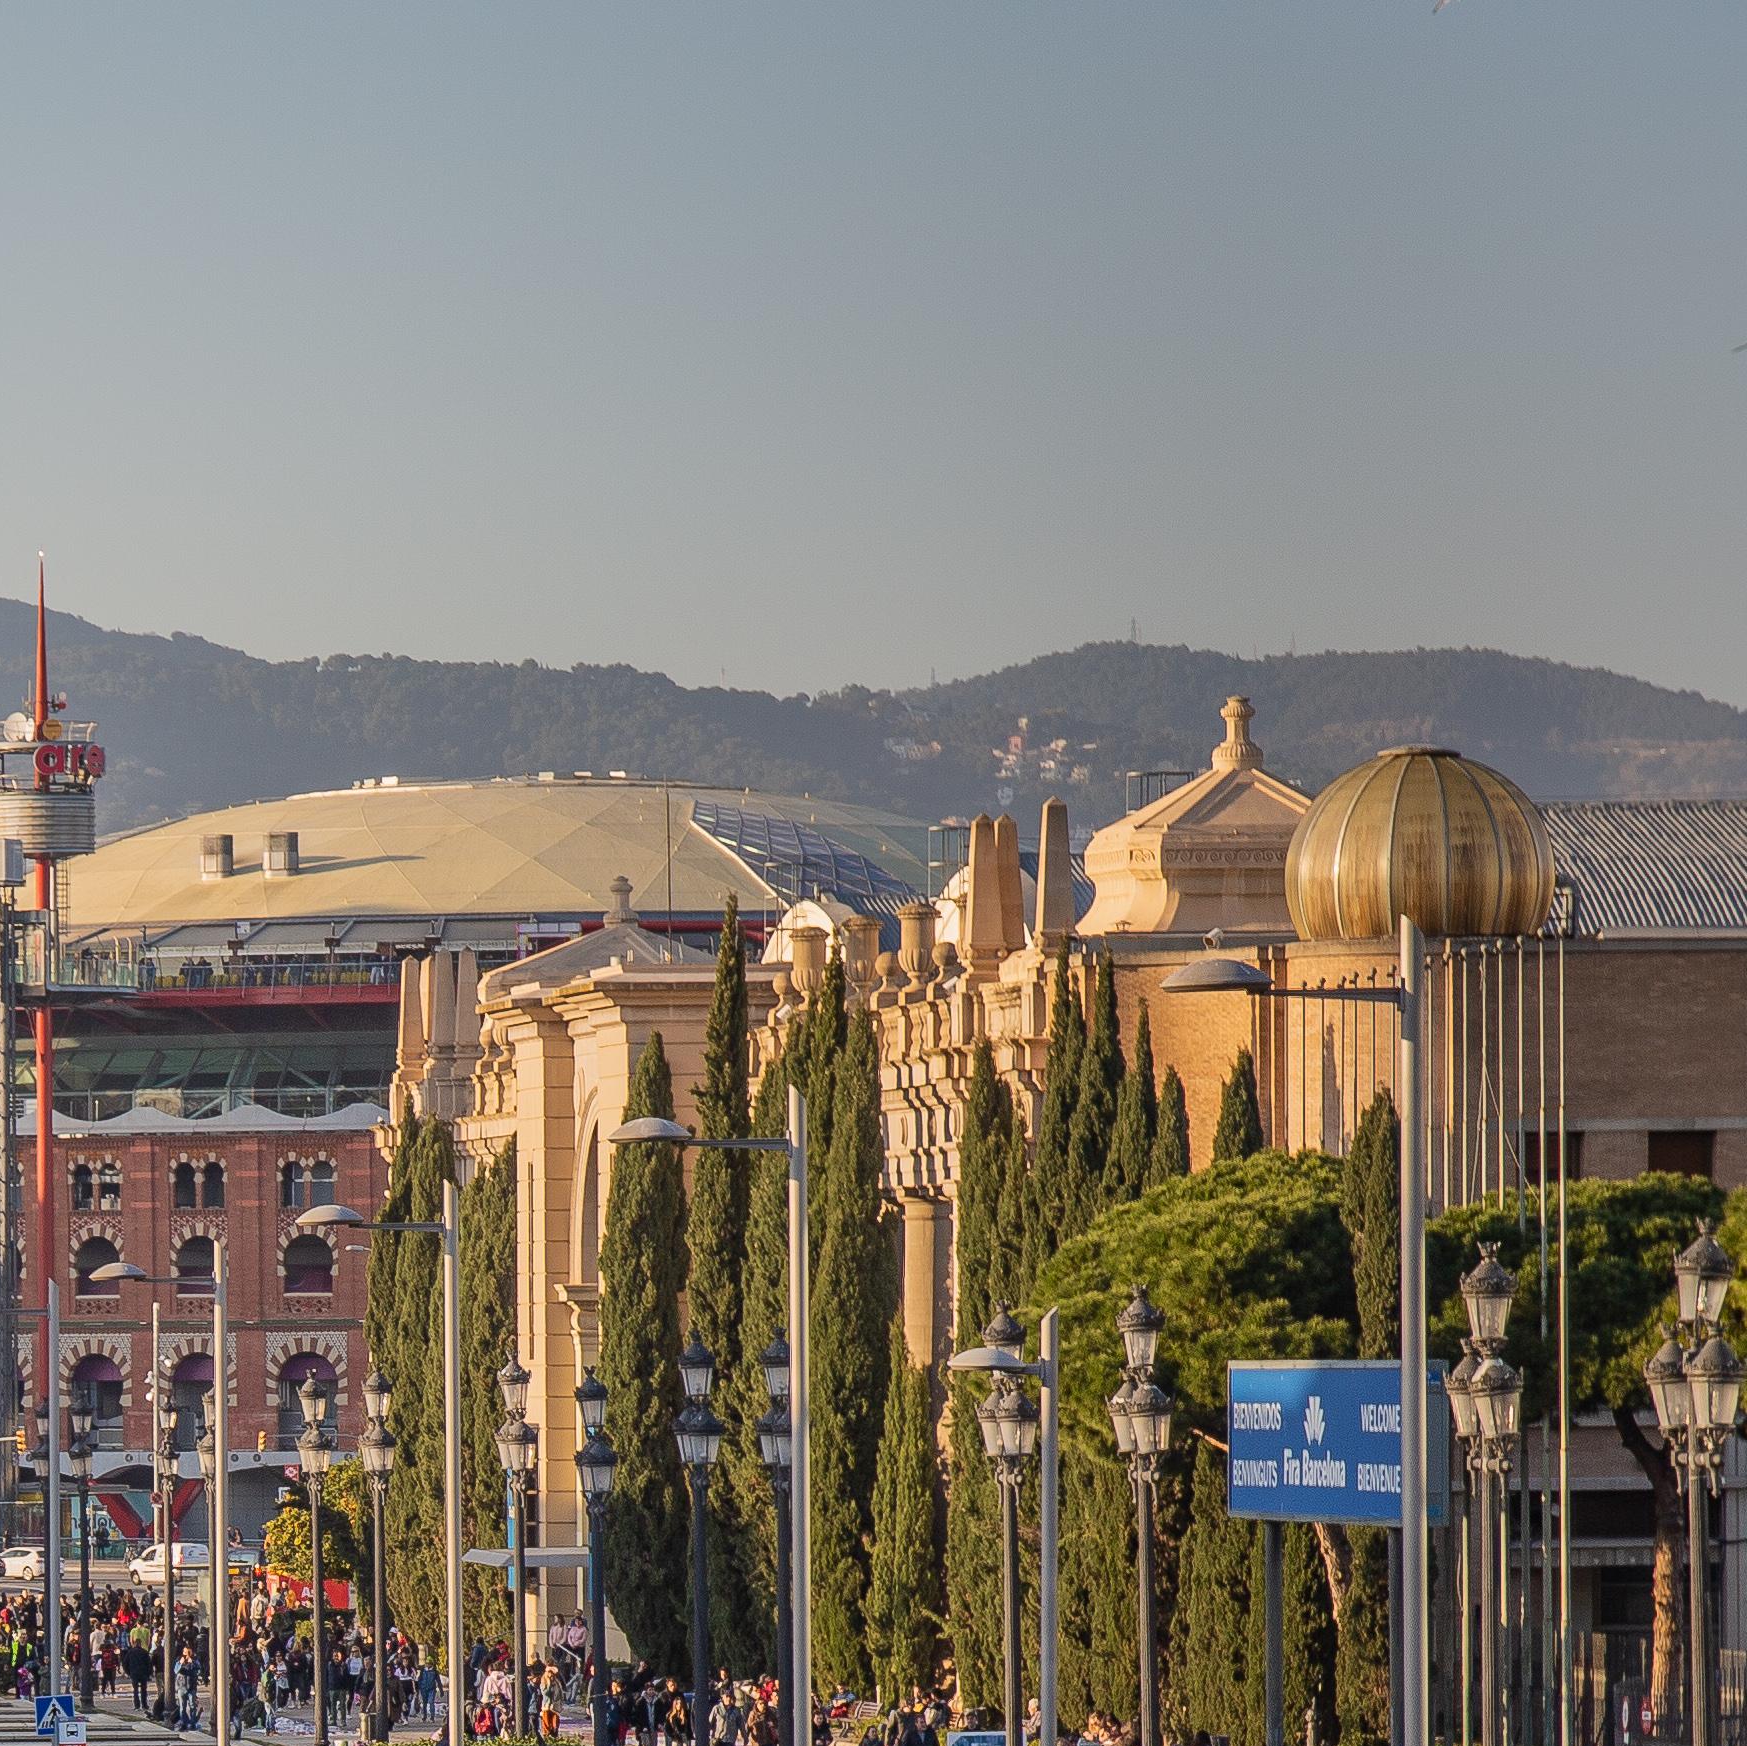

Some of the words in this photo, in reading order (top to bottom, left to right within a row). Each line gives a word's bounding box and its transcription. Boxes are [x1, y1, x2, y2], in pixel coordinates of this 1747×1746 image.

[1234, 1402, 1281, 1432] BIENVENIDOS
[1361, 1404, 1401, 1433] WELCOME
[1233, 1459, 1278, 1489] BENVINGUTS
[1358, 1463, 1401, 1494] BIENVENUE
[1283, 1448, 1301, 1486] Fira
[1303, 1449, 1346, 1488] Barcelona
